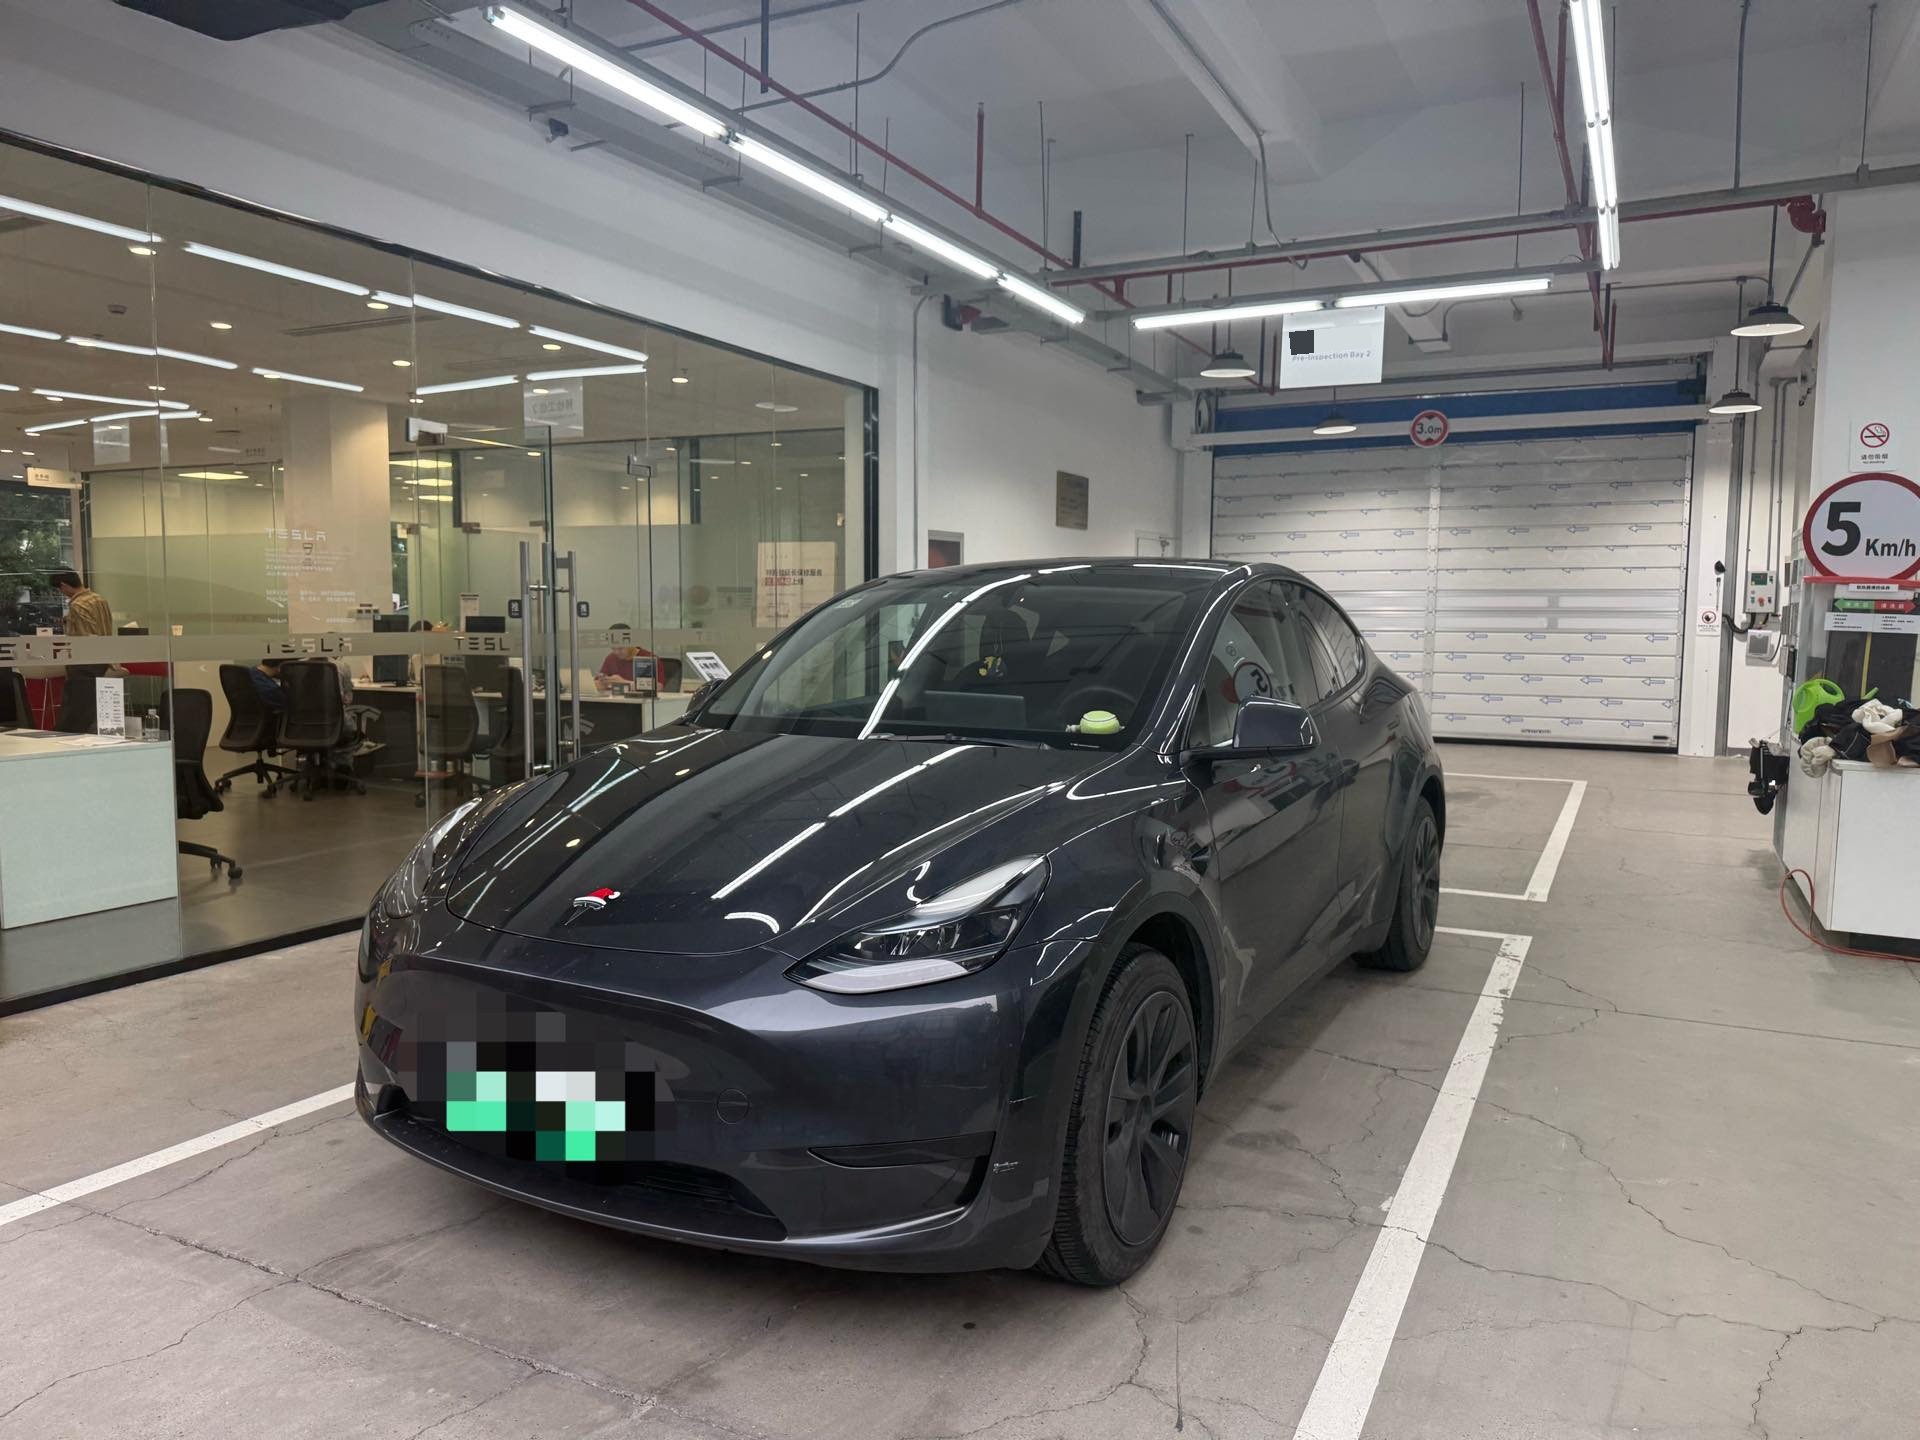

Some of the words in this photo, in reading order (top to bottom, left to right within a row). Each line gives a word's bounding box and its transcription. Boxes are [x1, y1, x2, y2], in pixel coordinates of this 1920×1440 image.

[1292, 352, 1349, 361] Pre-Inspection
[1350, 350, 1364, 359] Bay
[1417, 423, 1442, 434] 3.0m
[1821, 501, 1861, 557] 5
[1865, 538, 1916, 557] Km/h
